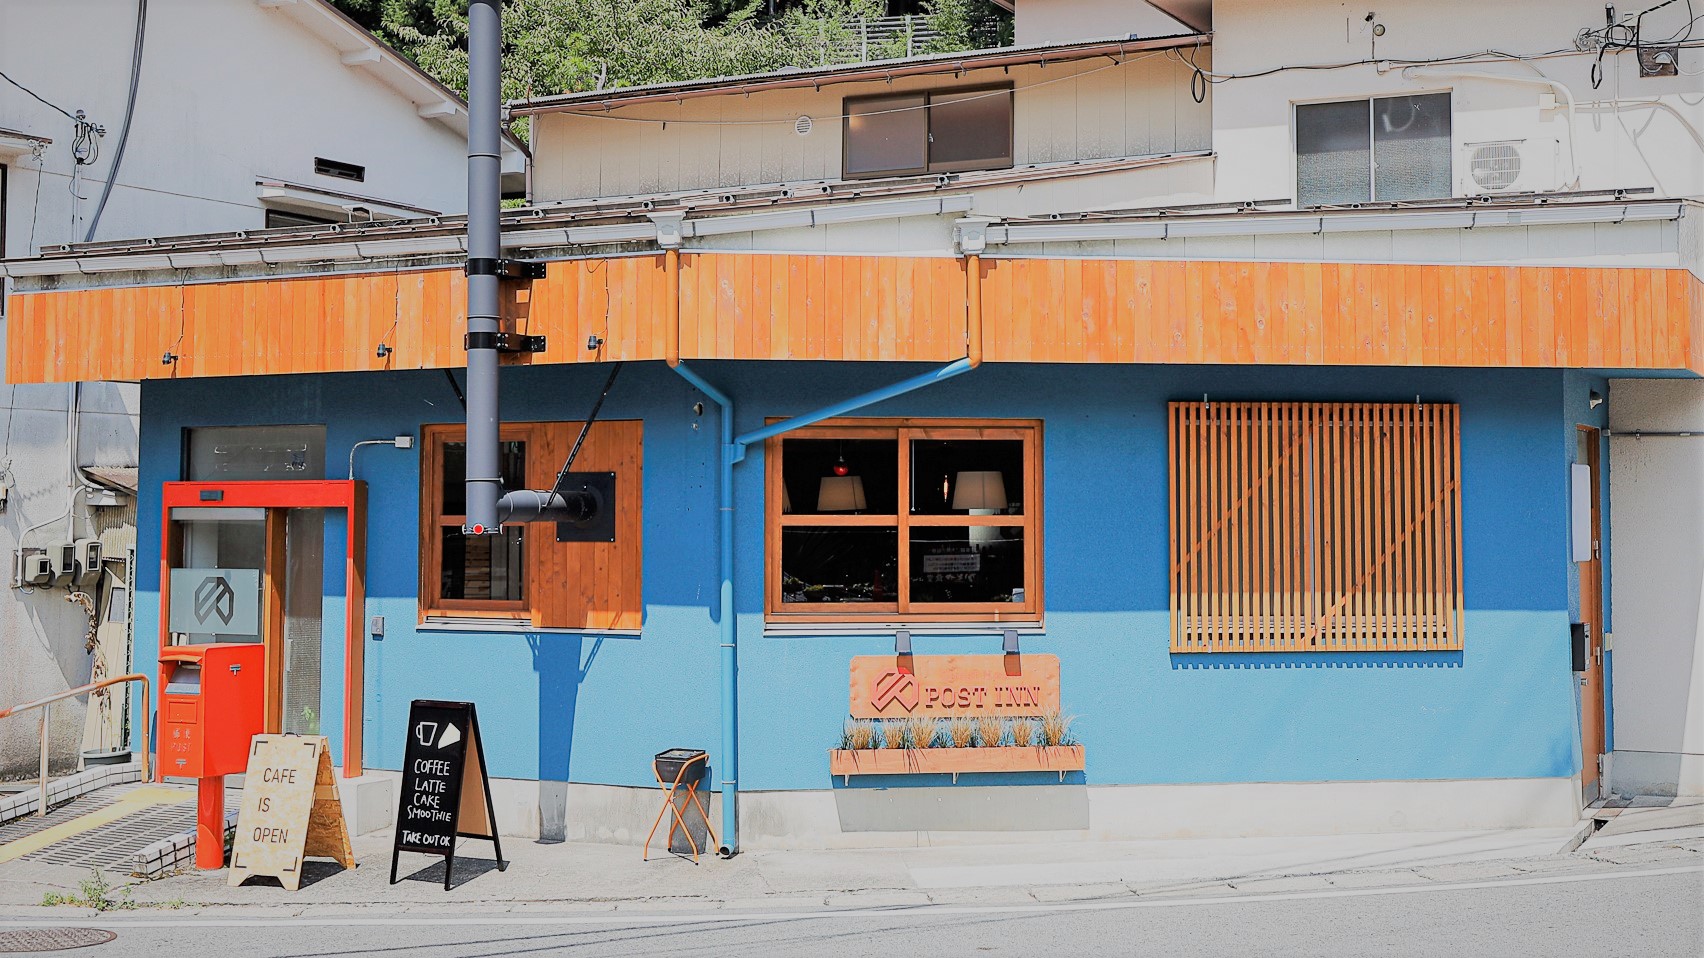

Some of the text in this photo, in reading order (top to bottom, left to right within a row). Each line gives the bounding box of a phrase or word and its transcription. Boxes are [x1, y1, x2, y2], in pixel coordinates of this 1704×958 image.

[925, 687, 1040, 708] POST INN
[414, 759, 450, 775] COFFEE
[263, 768, 297, 784] CAFE
[414, 778, 446, 793] LATTE
[257, 797, 270, 812] IS
[413, 793, 441, 809] CAKE
[407, 805, 451, 821] SMOOTHIE
[253, 827, 289, 844] OPEN
[402, 830, 421, 844] TAKE
